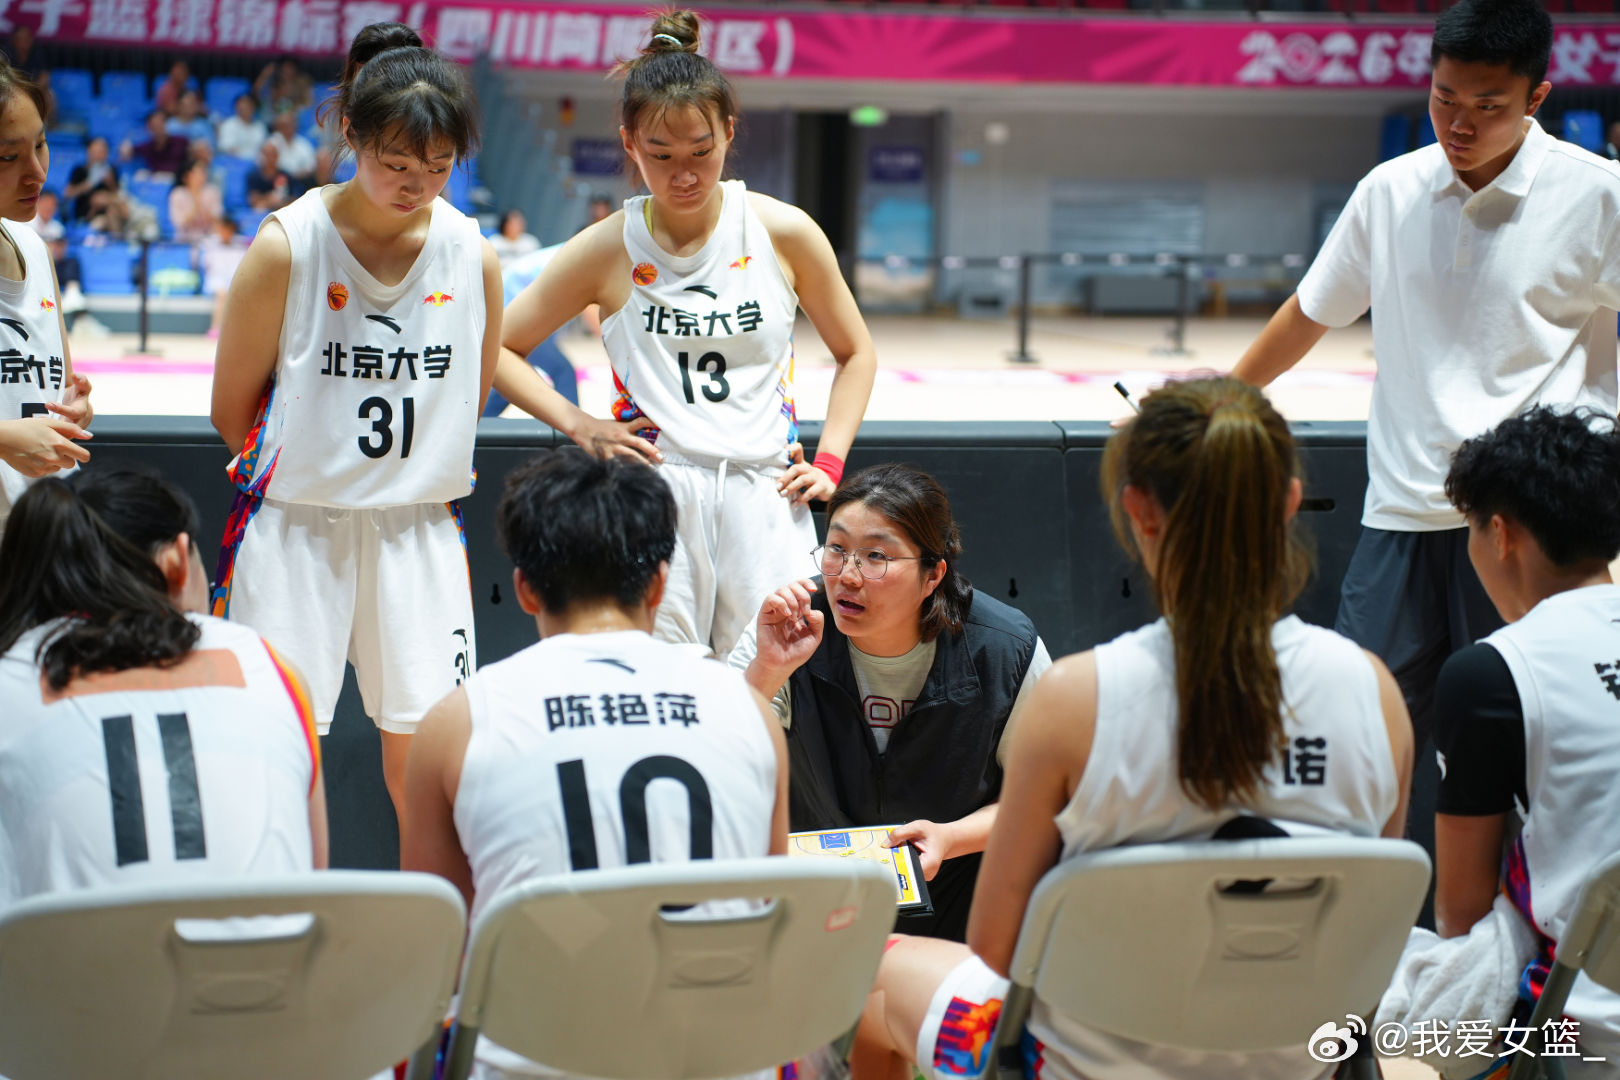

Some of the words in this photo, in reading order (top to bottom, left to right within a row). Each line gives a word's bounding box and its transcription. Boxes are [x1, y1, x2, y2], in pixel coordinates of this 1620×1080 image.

[641, 300, 764, 337] 北京大学
[321, 341, 452, 381] 北京大学
[678, 351, 731, 405] 13
[358, 396, 415, 459] 31
[544, 692, 700, 732] 陈艳萍
[102, 712, 207, 868] 11
[556, 755, 714, 873] 10
